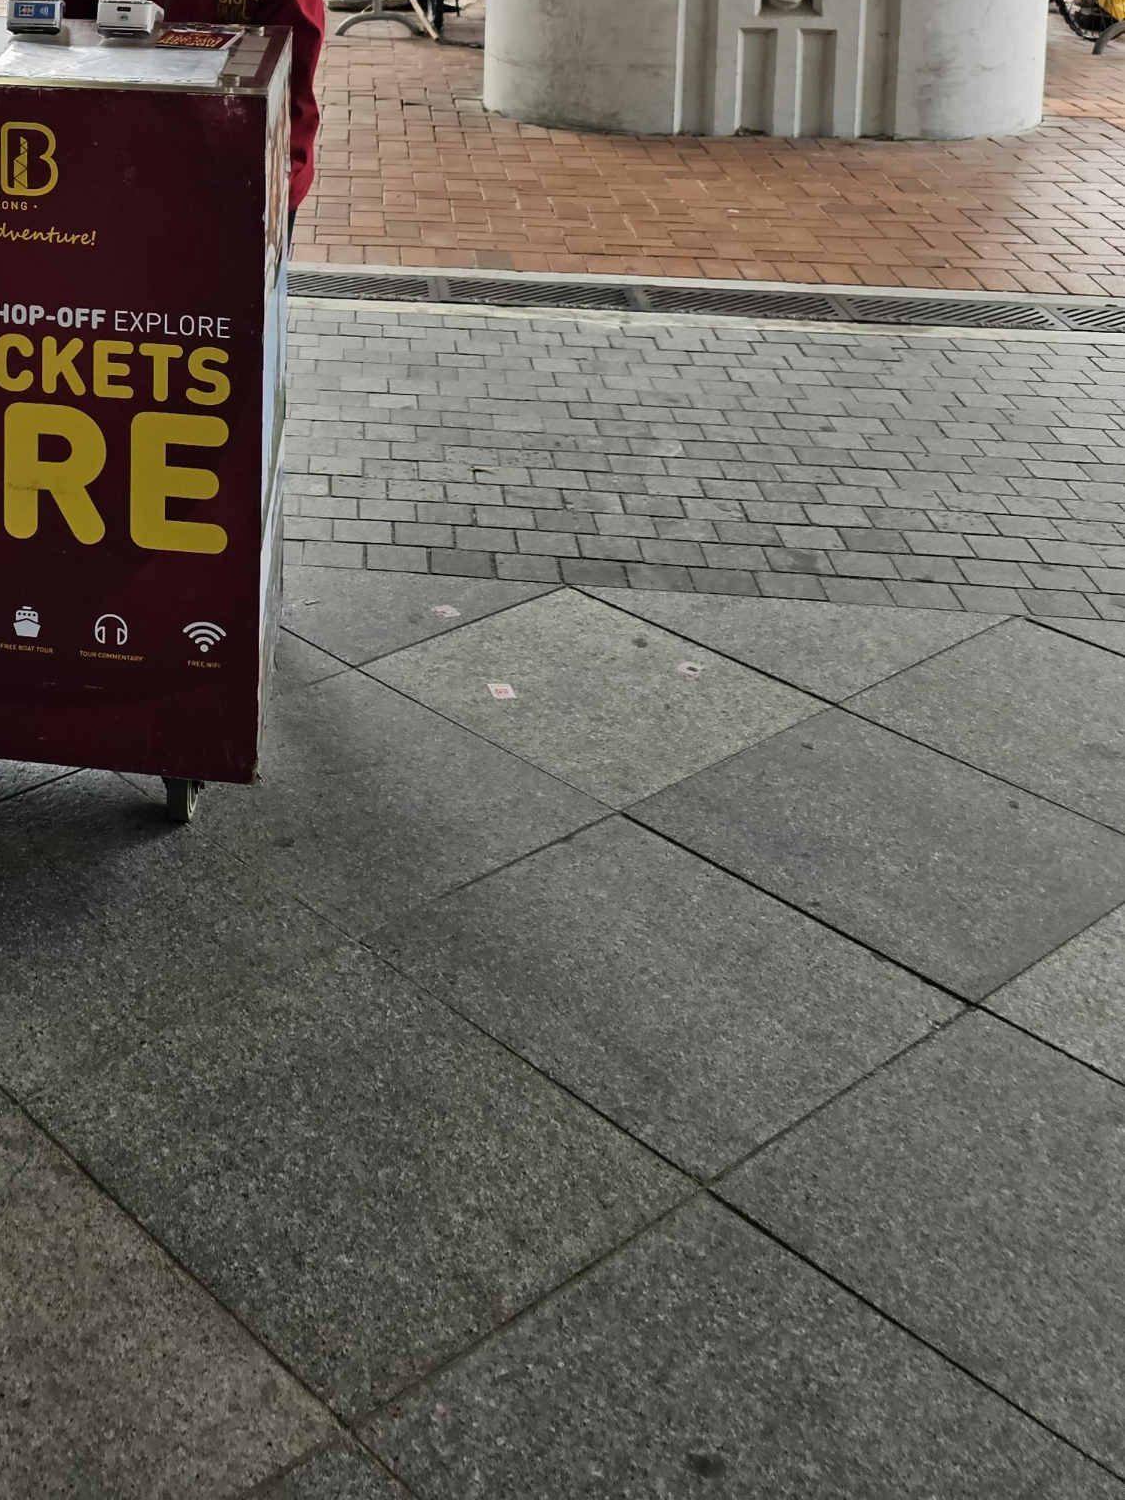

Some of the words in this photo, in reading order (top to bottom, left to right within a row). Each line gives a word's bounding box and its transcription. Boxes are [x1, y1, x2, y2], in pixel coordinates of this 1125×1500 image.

[114, 310, 231, 339] EXPLORE
[0, 642, 17, 651] FREE
[18, 644, 34, 652] BOAT
[36, 646, 54, 654] TOUR
[79, 650, 97, 658] TOUR
[97, 652, 144, 662] COMMENTARY
[187, 660, 205, 668] FREE
